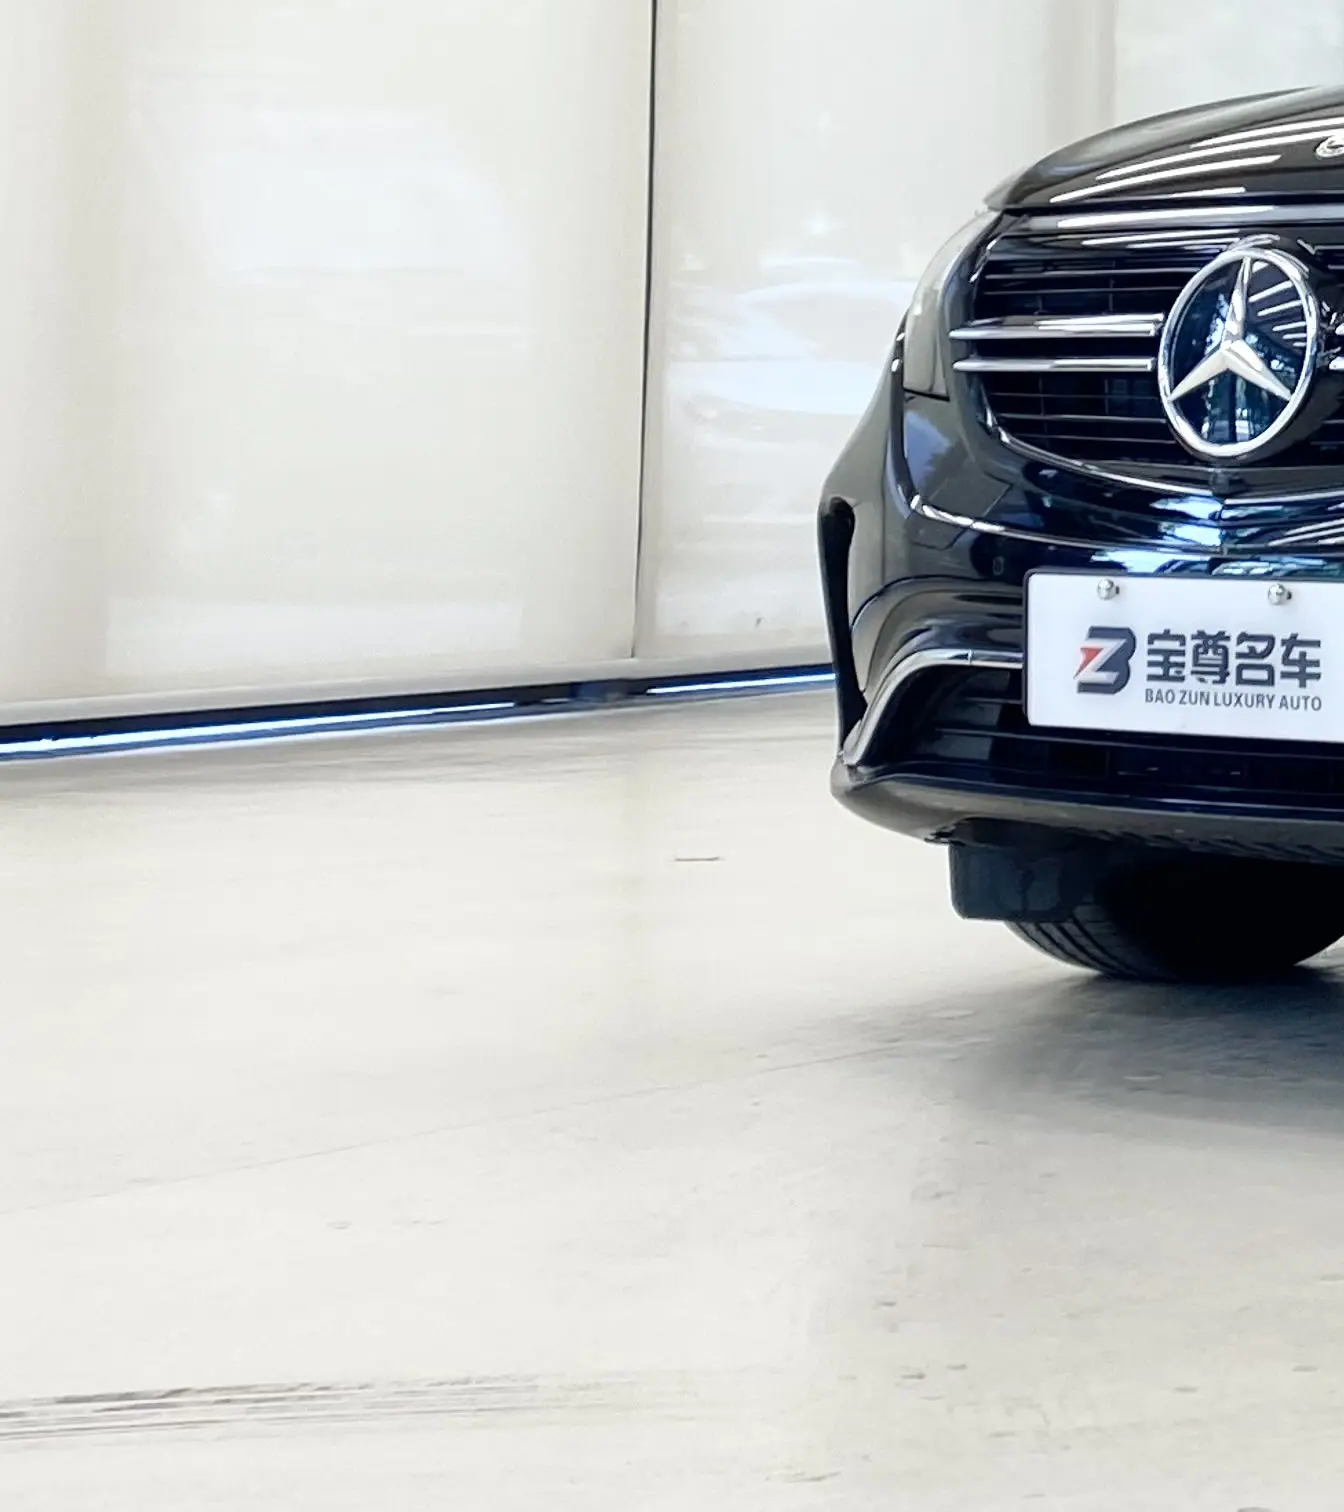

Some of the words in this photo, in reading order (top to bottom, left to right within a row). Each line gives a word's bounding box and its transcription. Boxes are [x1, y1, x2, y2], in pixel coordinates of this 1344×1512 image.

[1146, 629, 1322, 688] 宝尊名车
[1144, 688, 1175, 704] BAO
[1179, 690, 1210, 706] ZUN
[1213, 692, 1275, 709] LUXURY
[1279, 695, 1322, 712] AUTO
